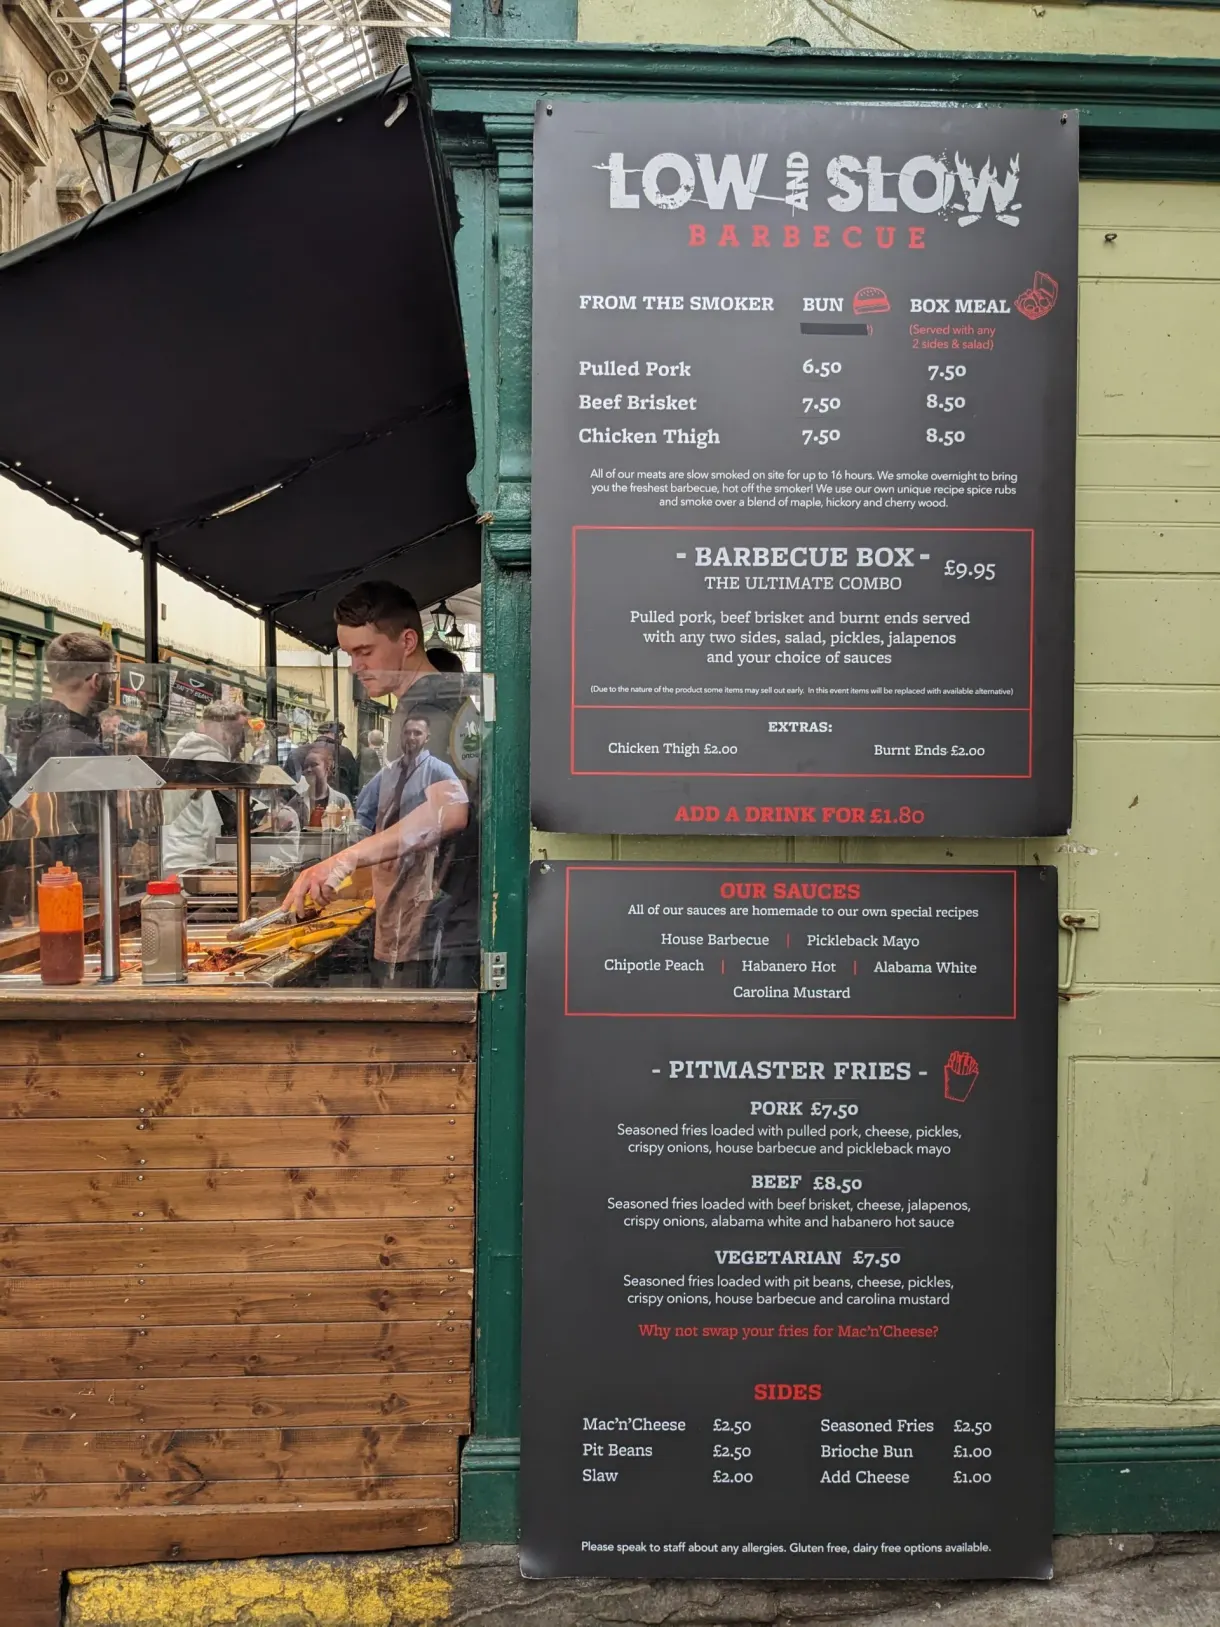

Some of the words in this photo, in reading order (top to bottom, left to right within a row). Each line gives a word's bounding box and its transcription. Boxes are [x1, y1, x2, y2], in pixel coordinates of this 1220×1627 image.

[592, 153, 768, 210] LOW
[785, 151, 809, 216] AND
[826, 150, 1022, 228] SLOW
[687, 223, 926, 250] BARBECUE
[579, 295, 637, 310] FROM
[642, 295, 684, 311] THE
[689, 295, 775, 311] SMOKER
[802, 297, 844, 312] BUN
[910, 298, 951, 314] BOX
[954, 298, 1011, 314] MEAL
[909, 323, 951, 336] (Served
[952, 324, 975, 335] with
[976, 327, 996, 338] any
[912, 338, 919, 349] 2
[921, 338, 949, 349] sides
[951, 338, 960, 349] &
[961, 338, 995, 351] salad)
[579, 360, 641, 377] Pulled
[645, 361, 692, 377] Pork
[802, 358, 842, 378] 6.50
[927, 364, 967, 381] 7.50
[578, 393, 623, 410] Beef
[626, 393, 698, 411] Brisket
[802, 397, 841, 414] 7.50
[926, 393, 966, 413] 8.50
[578, 427, 658, 444] Chicken
[662, 427, 721, 450] Thigh
[801, 429, 841, 446] 7.50
[926, 427, 966, 447] 8.50
[658, 495, 679, 507] and
[680, 495, 713, 507] smoke
[714, 499, 738, 507] over
[738, 499, 745, 507] a
[747, 496, 776, 507] blend
[777, 495, 789, 507] of
[790, 496, 824, 510] maple,
[825, 496, 862, 510] hickory
[862, 496, 883, 508] and
[884, 496, 917, 510] cherry
[917, 497, 949, 508] wood.
[694, 546, 848, 567] BARBECUE
[856, 547, 915, 568] BOX
[944, 559, 996, 581] £9.95
[704, 576, 740, 590] THE
[744, 576, 834, 590] ULTIMATE
[839, 576, 902, 591] COMBO
[590, 685, 609, 694] (Due
[617, 685, 630, 693] the
[653, 685, 662, 693] of
[662, 685, 675, 694] the
[674, 685, 703, 695] product
[724, 686, 744, 694] items
[744, 688, 760, 696] may
[760, 686, 773, 694] sell
[786, 686, 805, 696] early.
[807, 686, 815, 694] In
[815, 686, 829, 694] this
[829, 687, 850, 695] event
[849, 687, 870, 695] items
[870, 686, 883, 695] will
[883, 686, 894, 695] be
[894, 686, 926, 696] replaced
[926, 687, 942, 695] with
[942, 687, 974, 695] available
[974, 687, 1014, 696] alternative)
[768, 721, 833, 733] EXTRAS:
[608, 741, 660, 754] Chicken
[662, 742, 701, 758] Thigh
[703, 743, 738, 755] £2.00
[873, 744, 911, 756] Burnt
[914, 744, 949, 756] Ends
[950, 744, 986, 757] £2.00
[674, 805, 721, 823] ADD
[724, 806, 741, 823] A
[744, 805, 817, 823] DRINK
[821, 806, 866, 824] FOR
[869, 805, 925, 824] £1.80
[719, 882, 767, 900] OUR
[773, 882, 861, 901] SAUCES
[660, 933, 704, 946] House
[707, 933, 770, 946] Barbecue
[806, 933, 879, 947] Pickleback
[882, 935, 920, 951] Mayo
[604, 958, 661, 974] Chipotle
[664, 958, 705, 972] Peach
[741, 959, 808, 973] Habanero
[811, 960, 837, 973] Hot
[873, 960, 933, 974] Alabama
[935, 961, 978, 974] White
[733, 985, 790, 998] Carolina
[793, 986, 851, 999] Mustard
[668, 1060, 826, 1080] PITMASTER
[833, 1061, 912, 1081] FRIES
[750, 1100, 804, 1116] PORK
[810, 1101, 859, 1120] £7.50
[617, 1123, 679, 1136] Seasoned
[680, 1123, 708, 1137] fries
[710, 1123, 755, 1137] loaded
[757, 1123, 784, 1137] with
[786, 1124, 827, 1140] pulled
[829, 1124, 862, 1141] pork,
[864, 1124, 913, 1139] cheese,
[916, 1124, 962, 1141] pickles,
[751, 1174, 802, 1189] BEEF
[812, 1175, 863, 1194] £8.50
[714, 1250, 842, 1266] VEGETARIAN
[852, 1250, 901, 1268] £7.50
[637, 1323, 672, 1341] Why
[674, 1326, 699, 1337] not
[701, 1326, 740, 1341] swap
[741, 1327, 775, 1341] your
[777, 1323, 809, 1338] fries
[812, 1323, 834, 1338] for
[753, 1383, 823, 1401] SIDES
[712, 1418, 752, 1435] £2.50
[820, 1418, 893, 1433] Seasoned
[896, 1418, 935, 1433] Fries
[953, 1419, 992, 1436] £2.50
[582, 1442, 604, 1457] Pit
[607, 1443, 653, 1457] Beans
[712, 1444, 752, 1461] £2.50
[820, 1443, 879, 1458] Brioche
[883, 1444, 914, 1458] Bun
[953, 1444, 992, 1458] £1.00
[582, 1468, 619, 1482] Slaw
[712, 1469, 754, 1484] £2.00
[819, 1469, 852, 1484] Add
[855, 1470, 910, 1484] Cheese
[953, 1470, 992, 1484] £1.00
[581, 1540, 615, 1552] Please
[616, 1541, 647, 1555] speak
[648, 1543, 661, 1553] to
[663, 1541, 687, 1553] staff
[687, 1541, 719, 1553] about
[720, 1544, 740, 1556] any
[741, 1542, 787, 1556] allergies.
[789, 1542, 825, 1553] Gluten
[826, 1542, 851, 1555] free,
[852, 1542, 879, 1556] dairy
[880, 1541, 902, 1553] free
[903, 1542, 943, 1556] options
[944, 1541, 992, 1553] available.
